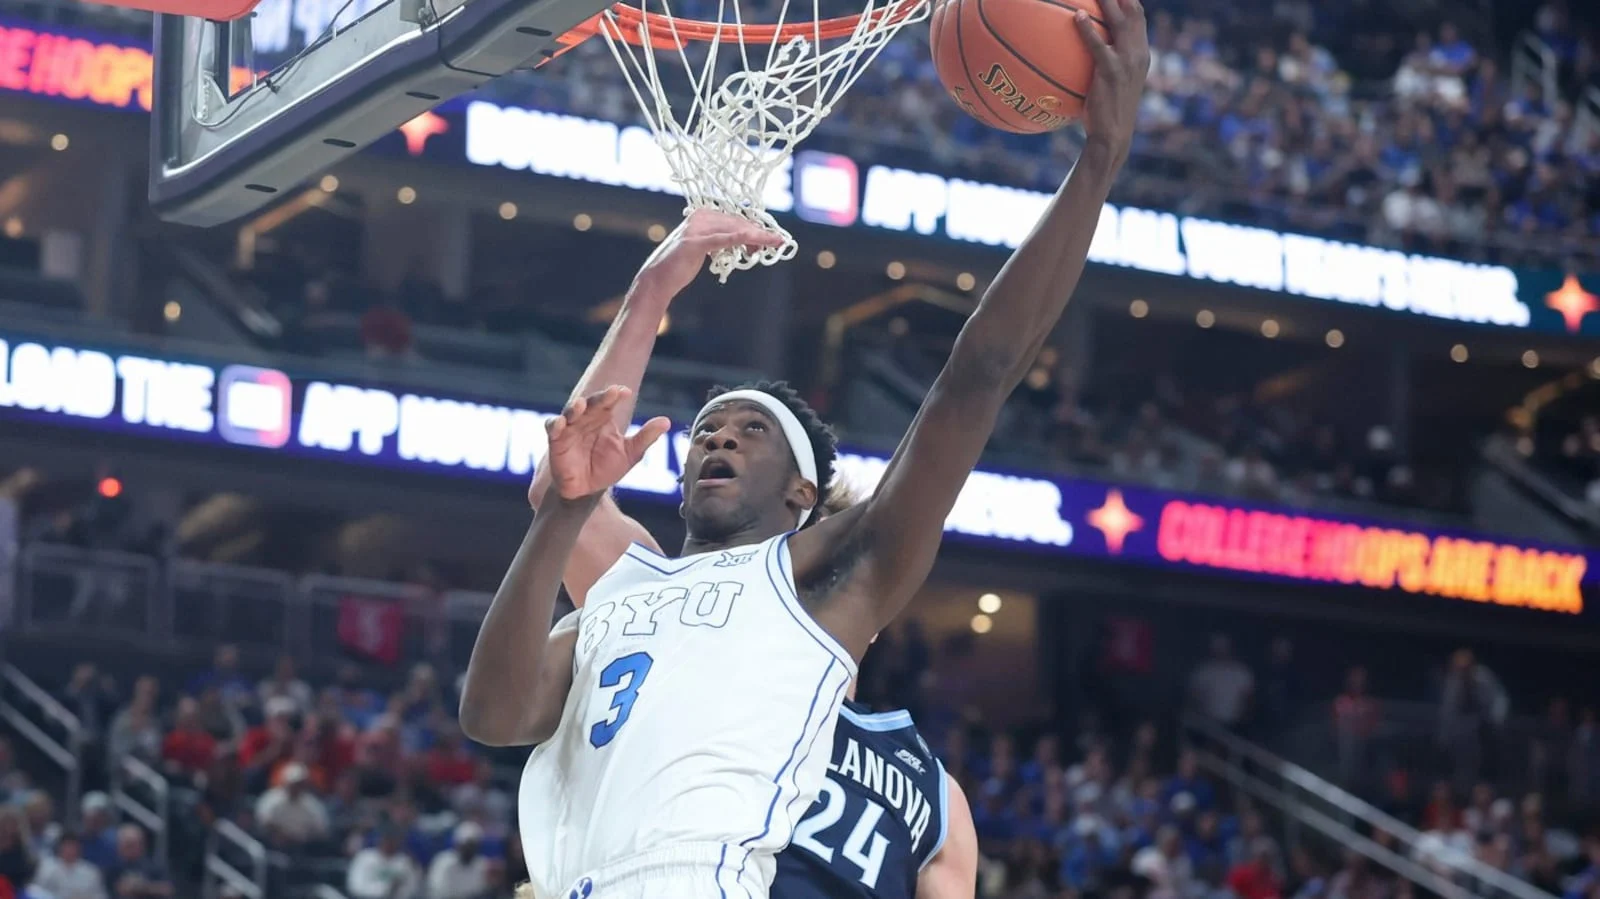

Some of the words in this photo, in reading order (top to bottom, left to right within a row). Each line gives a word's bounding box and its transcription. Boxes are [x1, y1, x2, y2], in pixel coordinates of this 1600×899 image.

[864, 167, 946, 231] APP
[117, 356, 214, 432] THE
[300, 382, 398, 455] APP
[1158, 500, 1309, 581] COLLEGE
[1305, 517, 1432, 593] HOOPS
[1426, 535, 1493, 603] ARE
[1491, 544, 1587, 615] BACK
[578, 581, 744, 656] BYU
[589, 651, 654, 749] 3
[791, 776, 891, 889] 24
